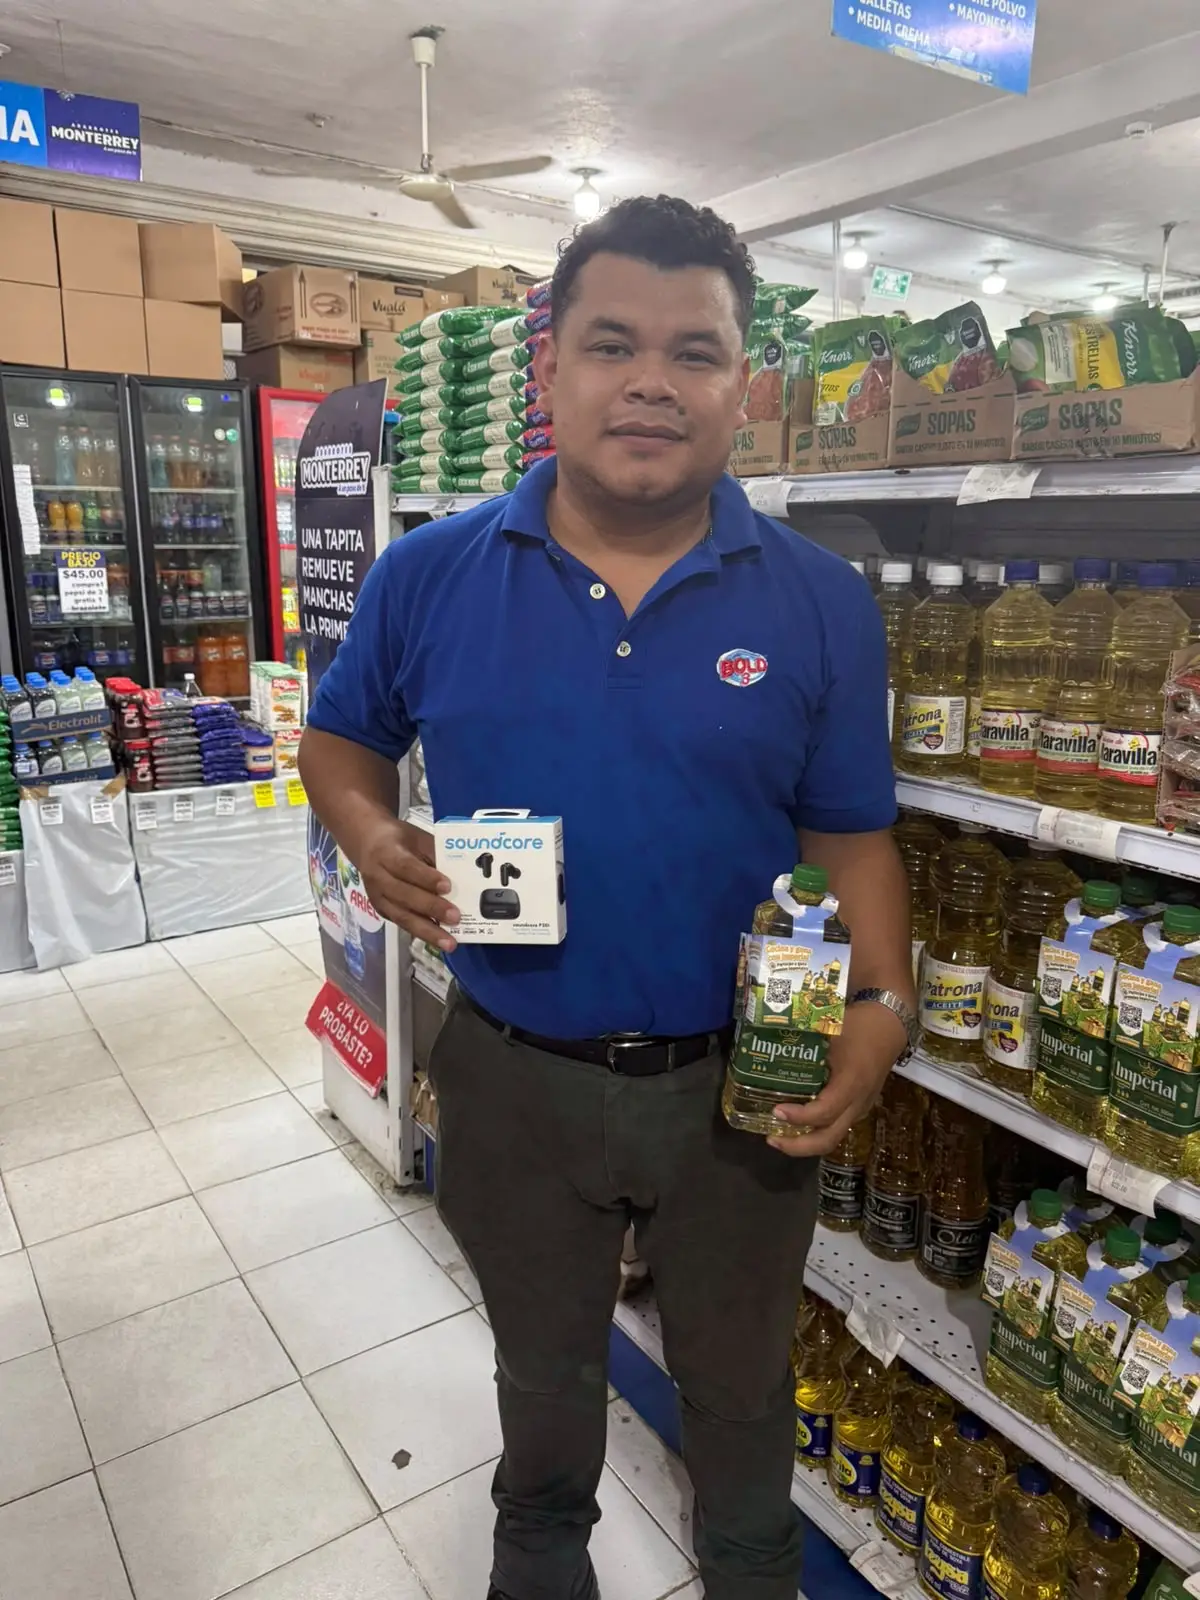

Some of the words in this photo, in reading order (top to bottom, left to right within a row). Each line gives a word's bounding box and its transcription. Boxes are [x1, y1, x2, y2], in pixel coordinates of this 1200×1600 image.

[956, 3, 1012, 32] MAYONESA
[992, 0, 1026, 19] POLVO
[857, 9, 892, 35] MEDIA
[895, 22, 930, 47] CREMA
[51, 125, 139, 150] MONTERREY
[819, 349, 852, 364] Knorr
[1122, 320, 1139, 380] Knorr
[927, 408, 976, 436] SOPAS
[1058, 398, 1122, 431] SOPAS
[303, 457, 368, 482] MONTERREY
[301, 528, 322, 550] UNA
[325, 529, 365, 552] TAPITA
[61, 551, 101, 561] PRECIO
[67, 559, 96, 568] BAJO
[63, 569, 104, 579] $45.00
[302, 557, 354, 583] REMUEVE
[303, 586, 354, 614] MANCHAS
[304, 613, 318, 636] LA
[720, 657, 768, 680] BOLD
[741, 672, 751, 686] 3
[48, 713, 103, 731] Electrolit
[904, 707, 942, 729] trona
[981, 724, 1029, 741] aravilla
[445, 832, 544, 850] soundcore
[350, 889, 381, 922] ARIEL
[336, 998, 355, 1023] ¿YA
[353, 1014, 370, 1036] LO
[932, 1000, 964, 1010] ACEITE
[987, 1003, 1019, 1017] rona
[319, 1005, 373, 1069] PROBASTE?
[752, 1035, 819, 1062] Imperial
[1040, 1029, 1093, 1066] Imperial
[1115, 1061, 1177, 1103] Imperial
[997, 1321, 1049, 1366] Imperial
[1063, 1362, 1117, 1412] Imperial
